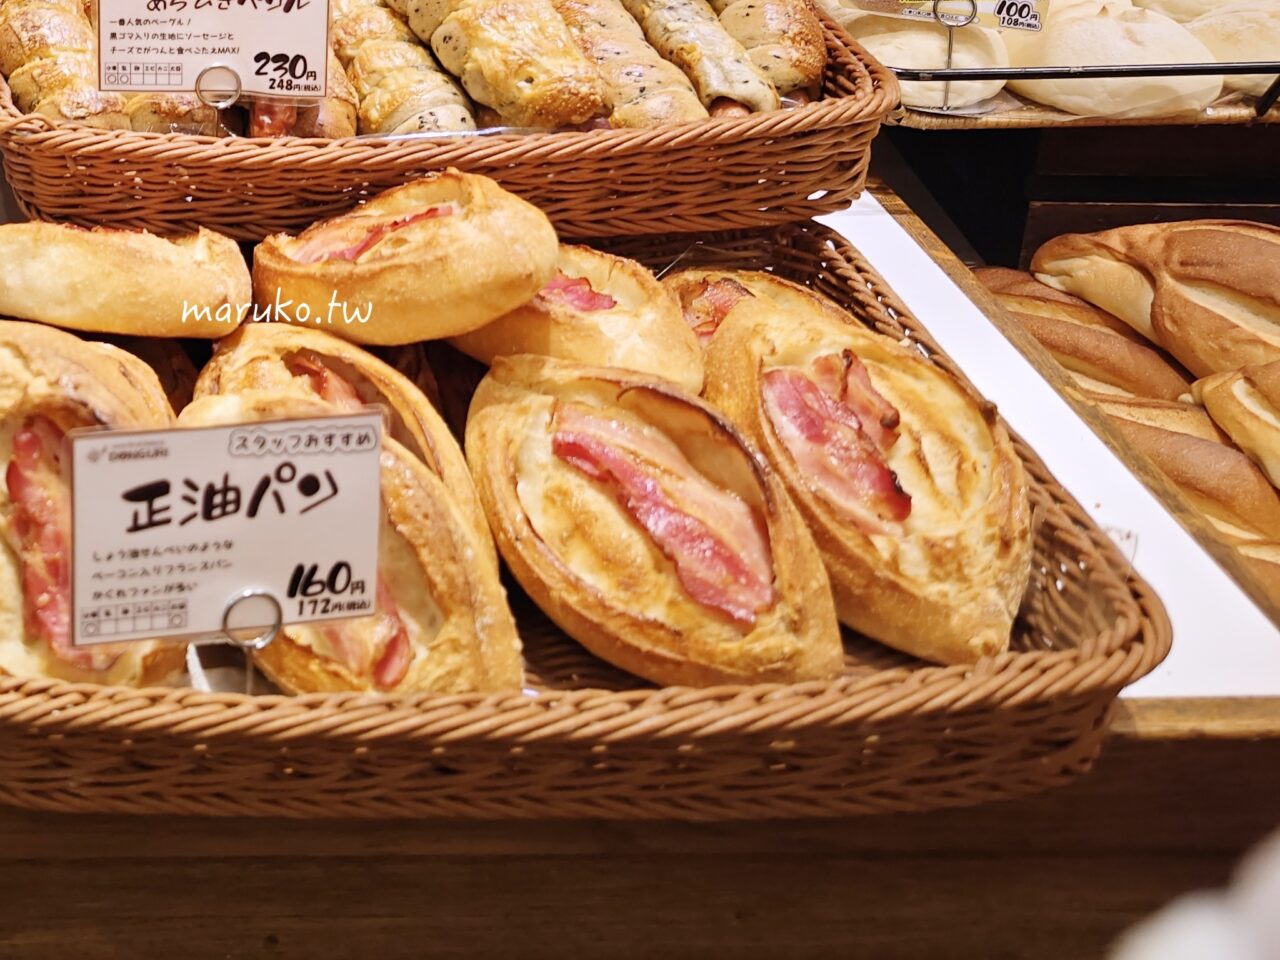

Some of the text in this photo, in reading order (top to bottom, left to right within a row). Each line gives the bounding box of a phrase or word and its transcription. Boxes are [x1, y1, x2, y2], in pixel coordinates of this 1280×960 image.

[253, 52, 317, 81] 230円
[235, 432, 372, 451] スタッフおすすめ
[121, 461, 339, 533] 正油パン
[286, 560, 365, 599] 160円
